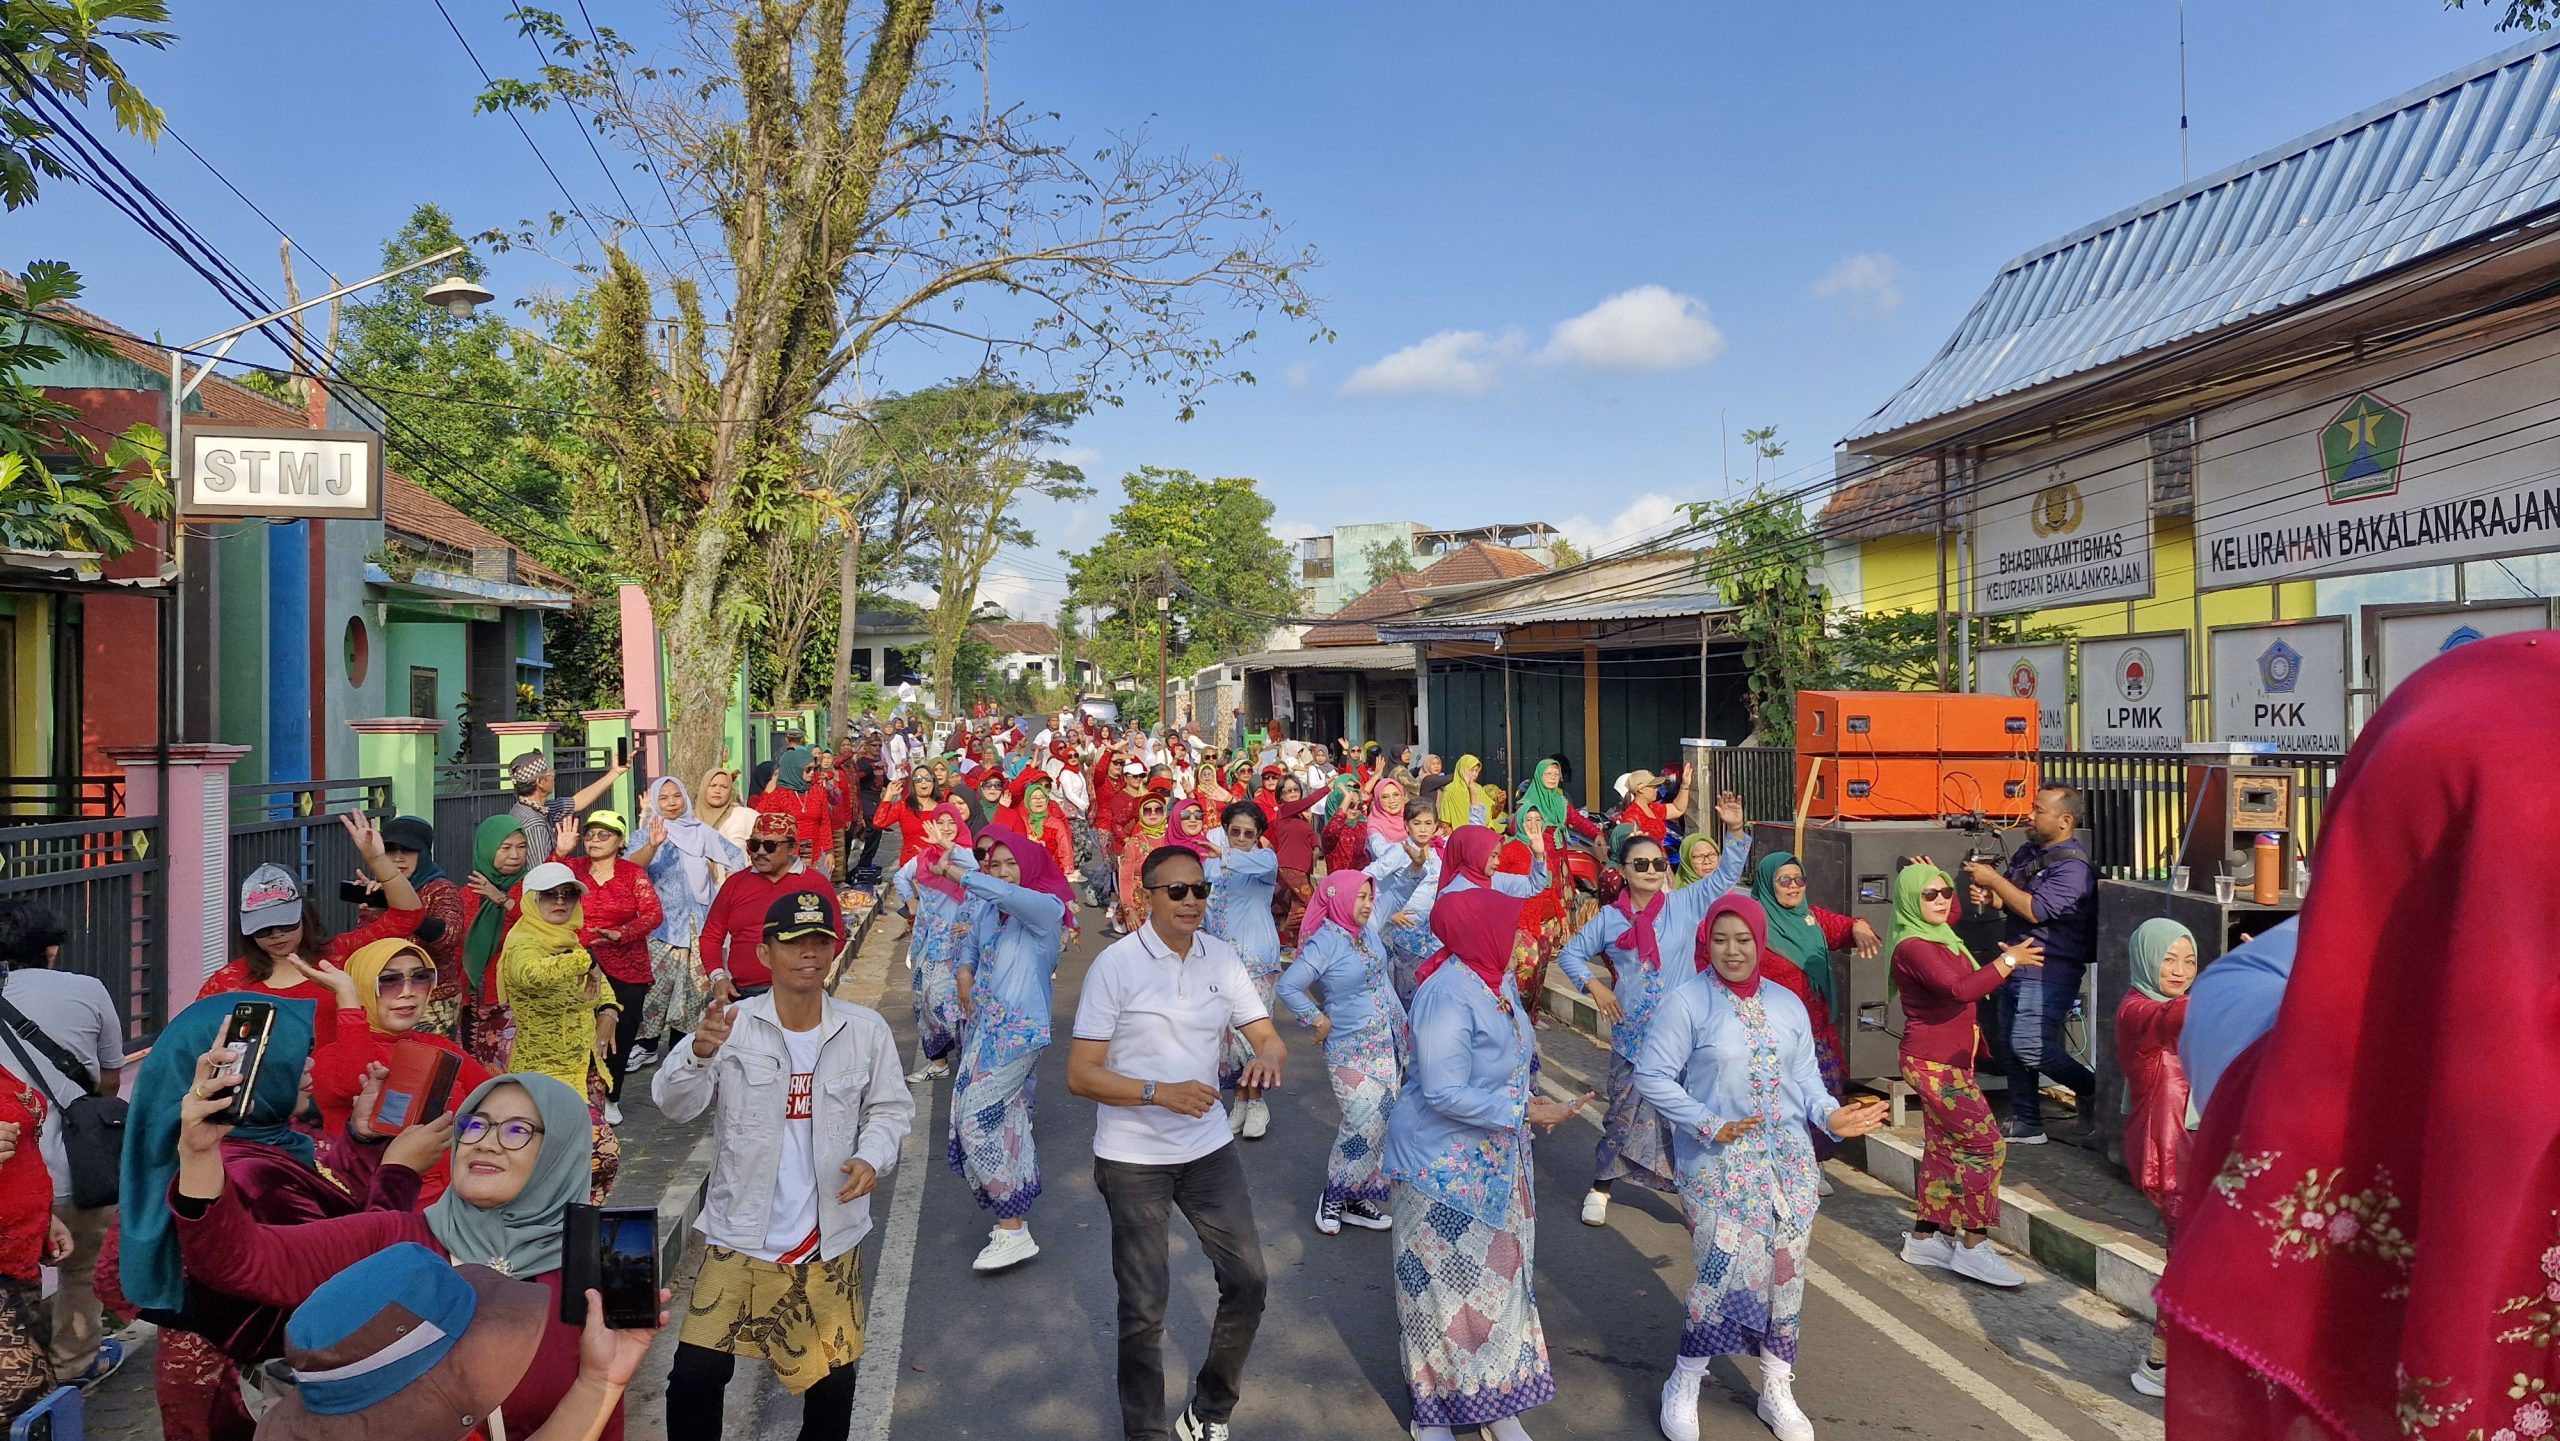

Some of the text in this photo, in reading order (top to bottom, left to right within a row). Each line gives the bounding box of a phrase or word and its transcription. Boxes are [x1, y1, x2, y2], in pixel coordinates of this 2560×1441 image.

[203, 449, 352, 496] STMJ
[2211, 487, 2560, 573] KELURAHAN BAKALANKRAJAN
[1999, 533, 2123, 575] BHABINKAMTIBMAS
[1986, 561, 2141, 602] KELURAHAN BAKALANKRAJAN
[2038, 709, 2063, 729] RUNA
[2107, 706, 2163, 729] LPMK
[2254, 702, 2307, 727] PKK
[2091, 735, 2183, 751] KELURAHAN BAKALANKRAJAN
